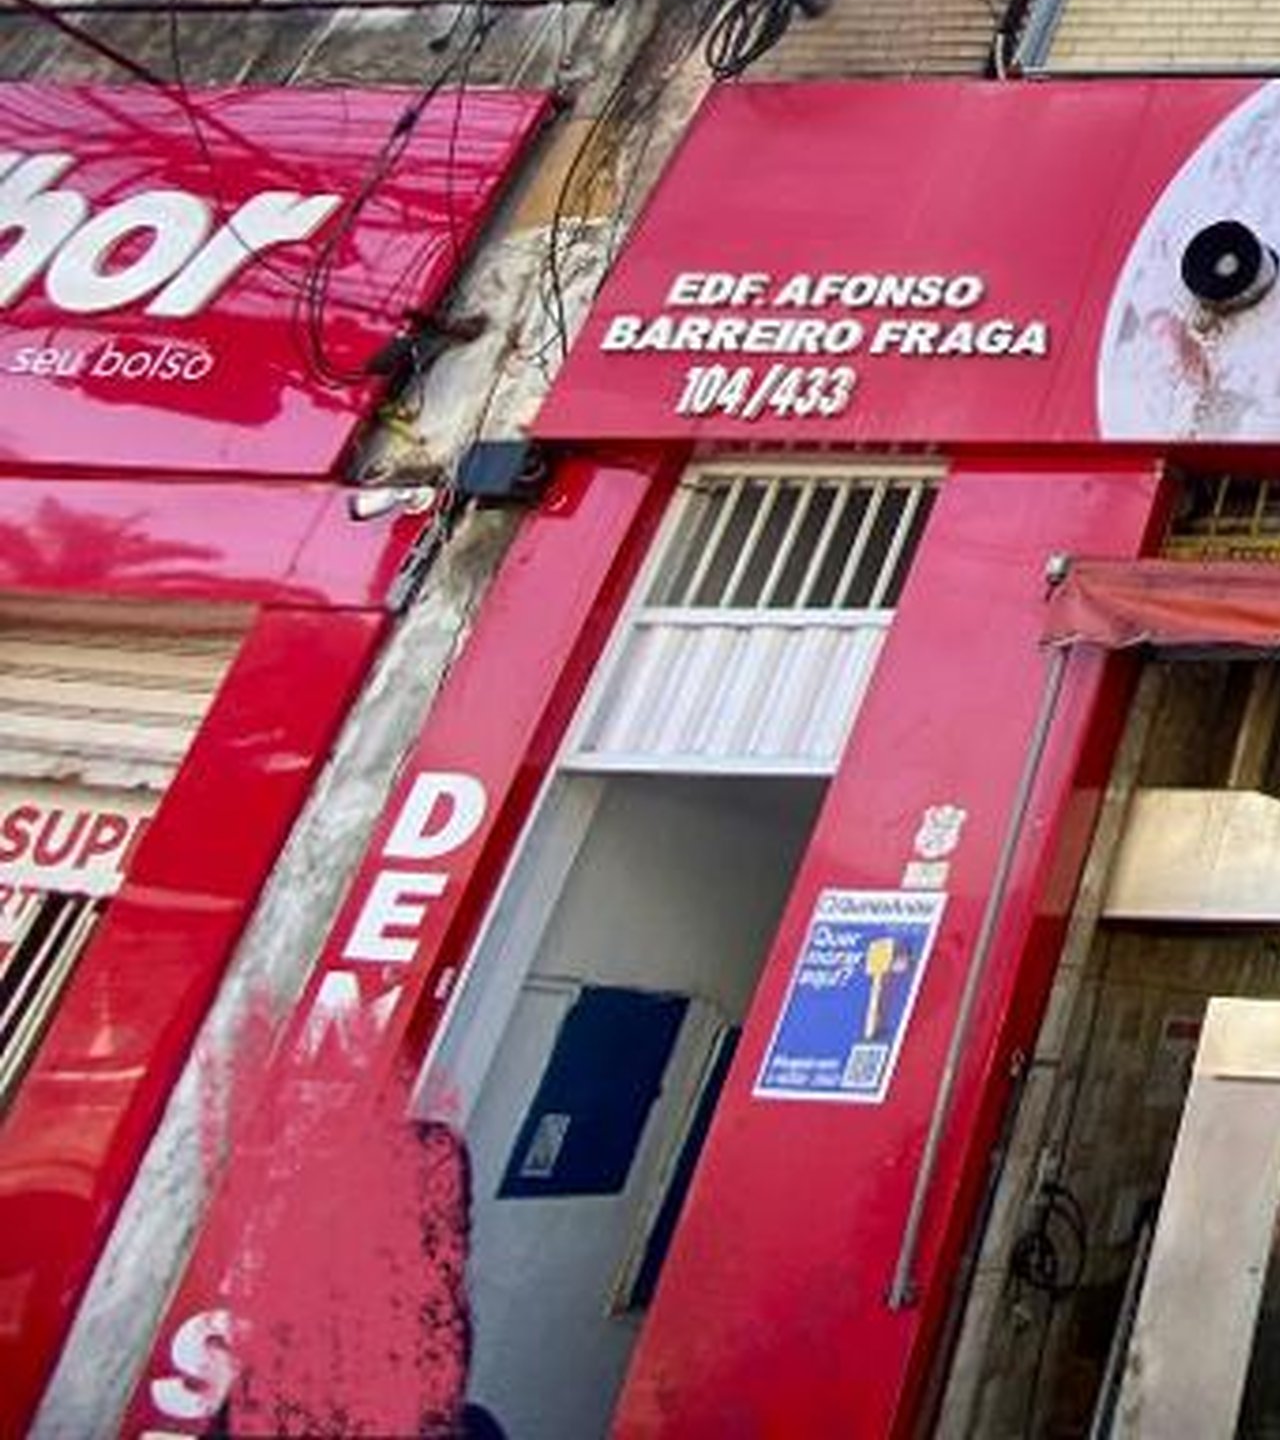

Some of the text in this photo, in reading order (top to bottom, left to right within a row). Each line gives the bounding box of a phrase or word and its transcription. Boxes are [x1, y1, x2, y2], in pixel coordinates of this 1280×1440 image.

[667, 273, 984, 308] EDF. AFONSO
[600, 315, 1048, 355] BARREIRO FRAGA
[8, 336, 214, 380] seu bolso
[675, 363, 857, 421] 104/433
